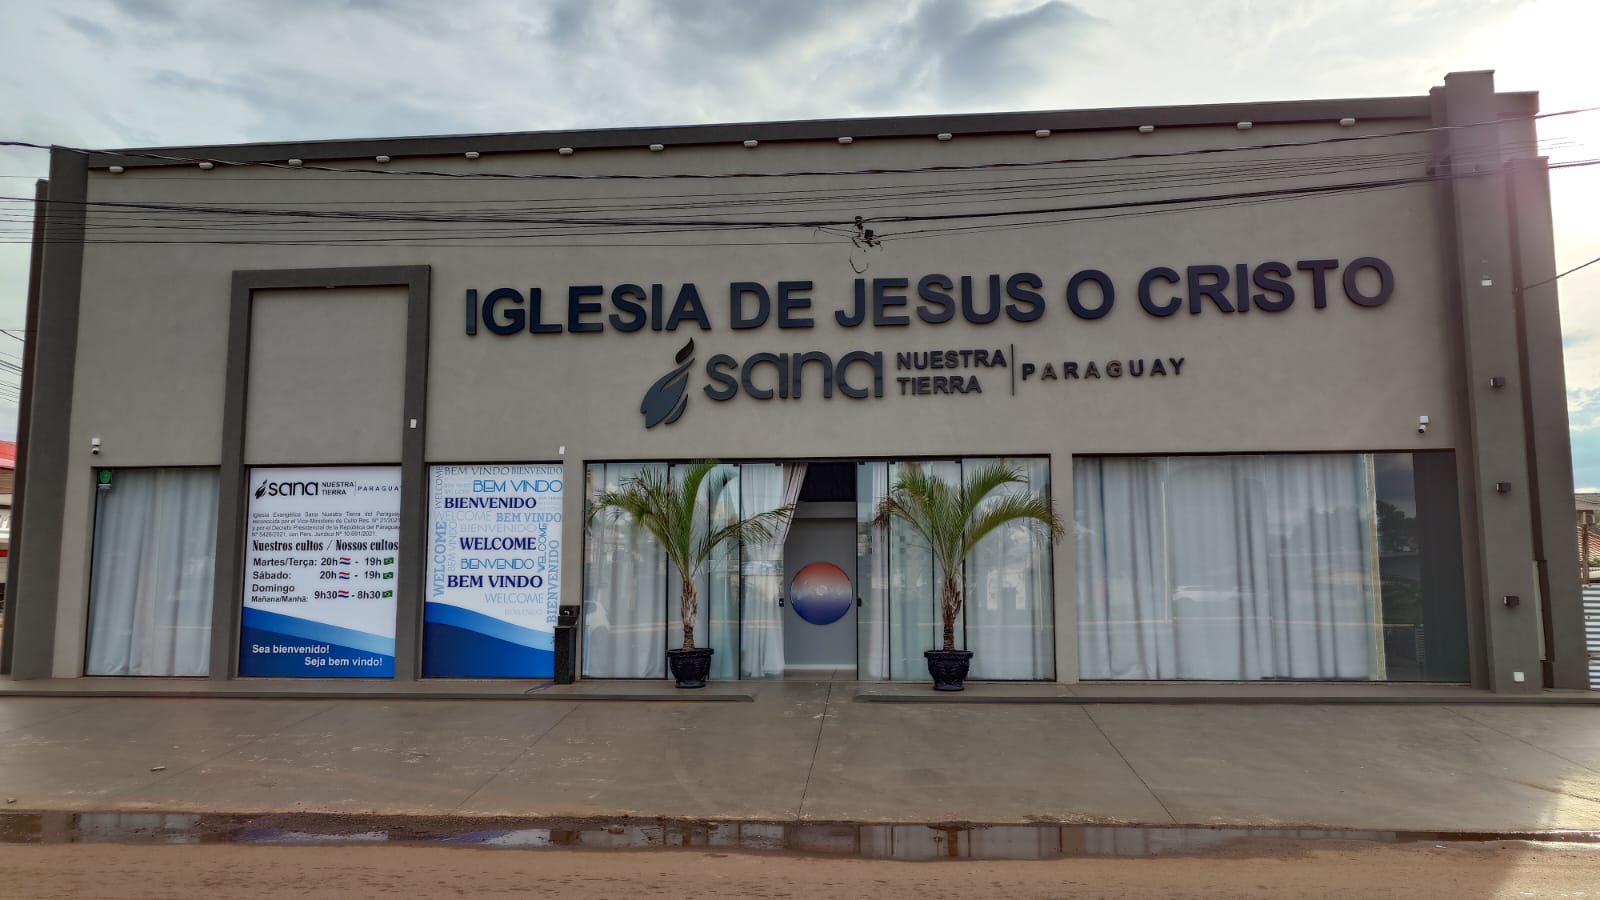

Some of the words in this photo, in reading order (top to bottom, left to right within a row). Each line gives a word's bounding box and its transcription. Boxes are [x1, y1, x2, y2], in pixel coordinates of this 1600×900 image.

[466, 283, 711, 335] IGLESIA
[730, 280, 814, 329] DE
[834, 272, 1046, 327] JESUS
[1066, 269, 1115, 320] O
[1137, 257, 1394, 317] CRISTO
[896, 349, 1007, 370] NUESTRA
[703, 350, 883, 401] sana
[1021, 357, 1185, 381] PARAGUAY
[896, 376, 982, 395] TIERRA
[445, 467, 467, 475] BEM
[471, 466, 510, 475] VINDO
[511, 466, 562, 475] BIENVENIDO
[268, 481, 318, 496] sana
[435, 466, 443, 509] WELCOME
[473, 480, 506, 493] BEM
[510, 480, 562, 493] VINDO
[444, 497, 537, 509] BIENVENIDO
[496, 513, 520, 522] BEM
[524, 513, 562, 522] VINDO
[252, 540, 292, 551] Nuestros
[296, 540, 323, 551] cultos
[327, 540, 334, 551] /
[336, 539, 367, 551] Nossos
[371, 539, 399, 551] cultos
[460, 537, 537, 550] WELCOME
[253, 557, 317, 567] Martes/Terça:
[321, 557, 338, 566] 20h
[365, 557, 382, 565] 19h
[433, 521, 447, 597] WELCOME
[252, 571, 292, 580] Sábado:
[320, 571, 337, 579] 20h
[364, 570, 381, 579] 19h
[447, 575, 483, 588] BEM
[488, 575, 543, 588] VINDO
[547, 539, 559, 623] BIENVENIDO
[252, 584, 295, 594] Domingo
[314, 590, 338, 599] 9h30
[357, 590, 381, 599] 8h30
[485, 593, 544, 604] WELCOME
[252, 645, 270, 653] Sea
[273, 645, 330, 653] bienvenido!
[304, 657, 326, 667] Seja
[328, 657, 349, 666] bem
[352, 657, 383, 666] vindo!
